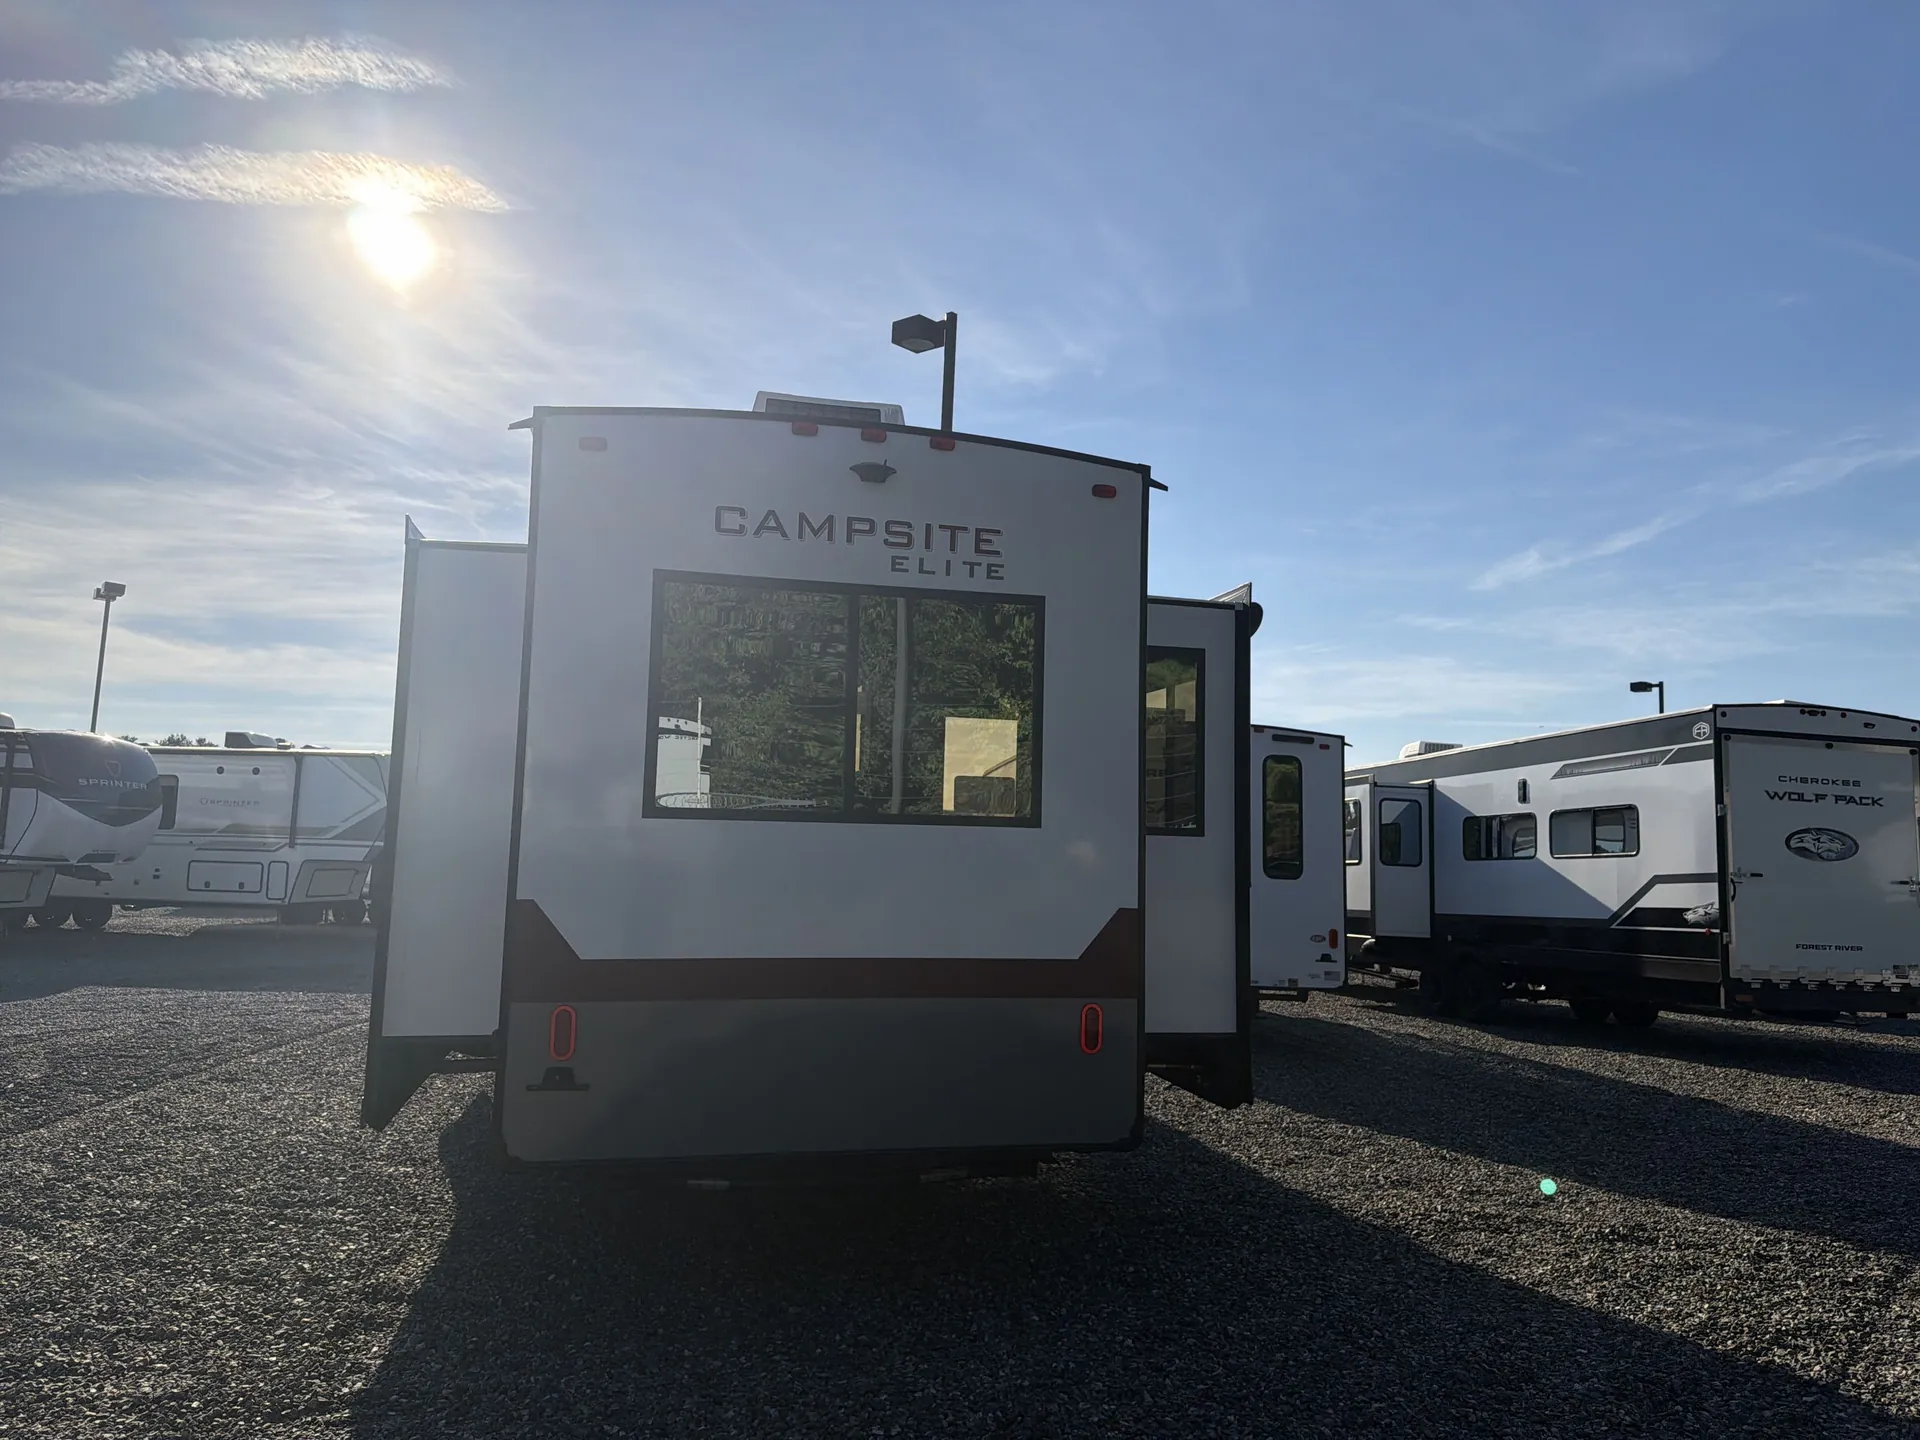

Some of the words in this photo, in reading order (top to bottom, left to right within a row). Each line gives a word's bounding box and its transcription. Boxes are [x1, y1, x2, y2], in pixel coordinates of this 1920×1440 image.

[714, 505, 1004, 557] CAMPSITE
[890, 555, 1005, 580] ELITE
[78, 778, 147, 790] SPRINTER
[1778, 775, 1862, 788] CHEROKEE
[1764, 789, 1829, 803] WOLF
[1830, 793, 1885, 807] PACK
[1795, 943, 1833, 951] FOREST
[1834, 944, 1863, 952] RIVER
